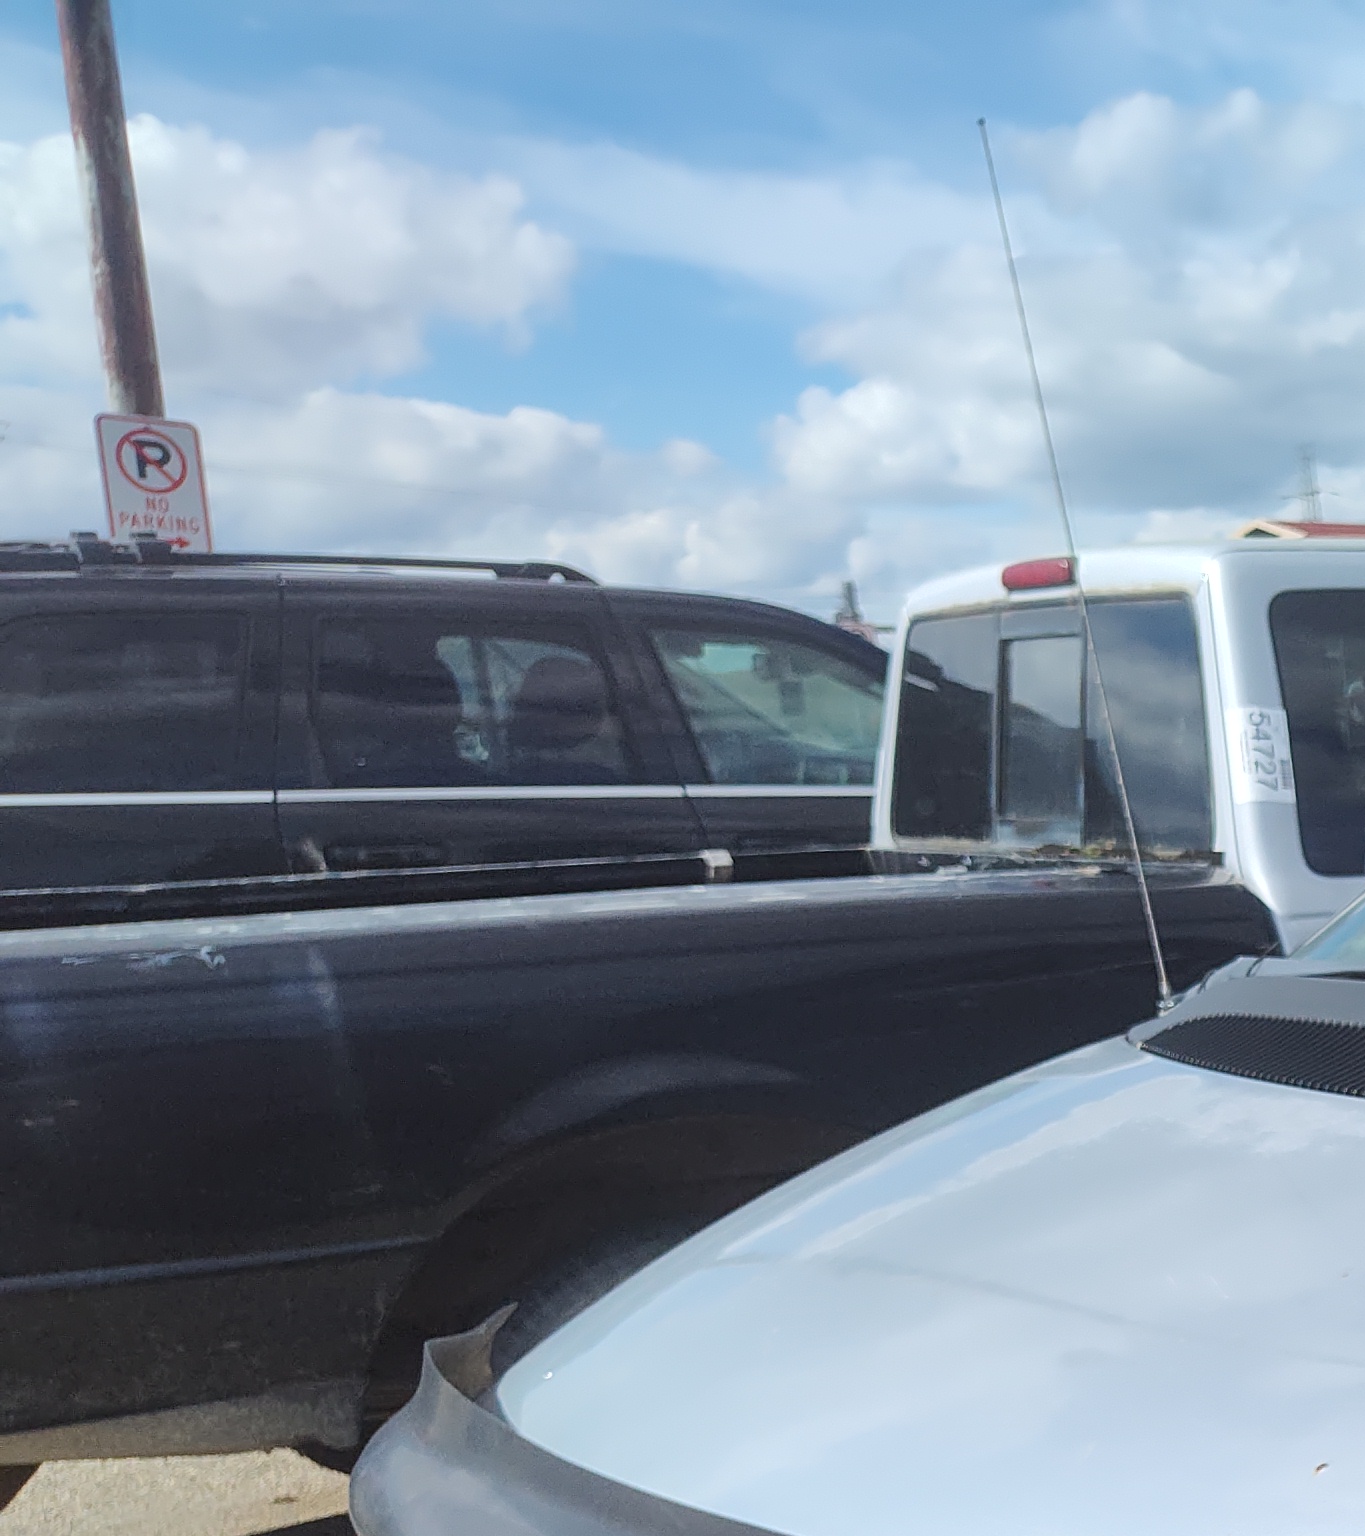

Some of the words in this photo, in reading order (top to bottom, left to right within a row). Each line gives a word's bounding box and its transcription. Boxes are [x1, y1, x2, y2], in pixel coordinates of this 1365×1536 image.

[132, 438, 172, 480] P
[145, 496, 170, 513] NO
[117, 510, 200, 534] PARKING
[1248, 711, 1279, 792] 54727
